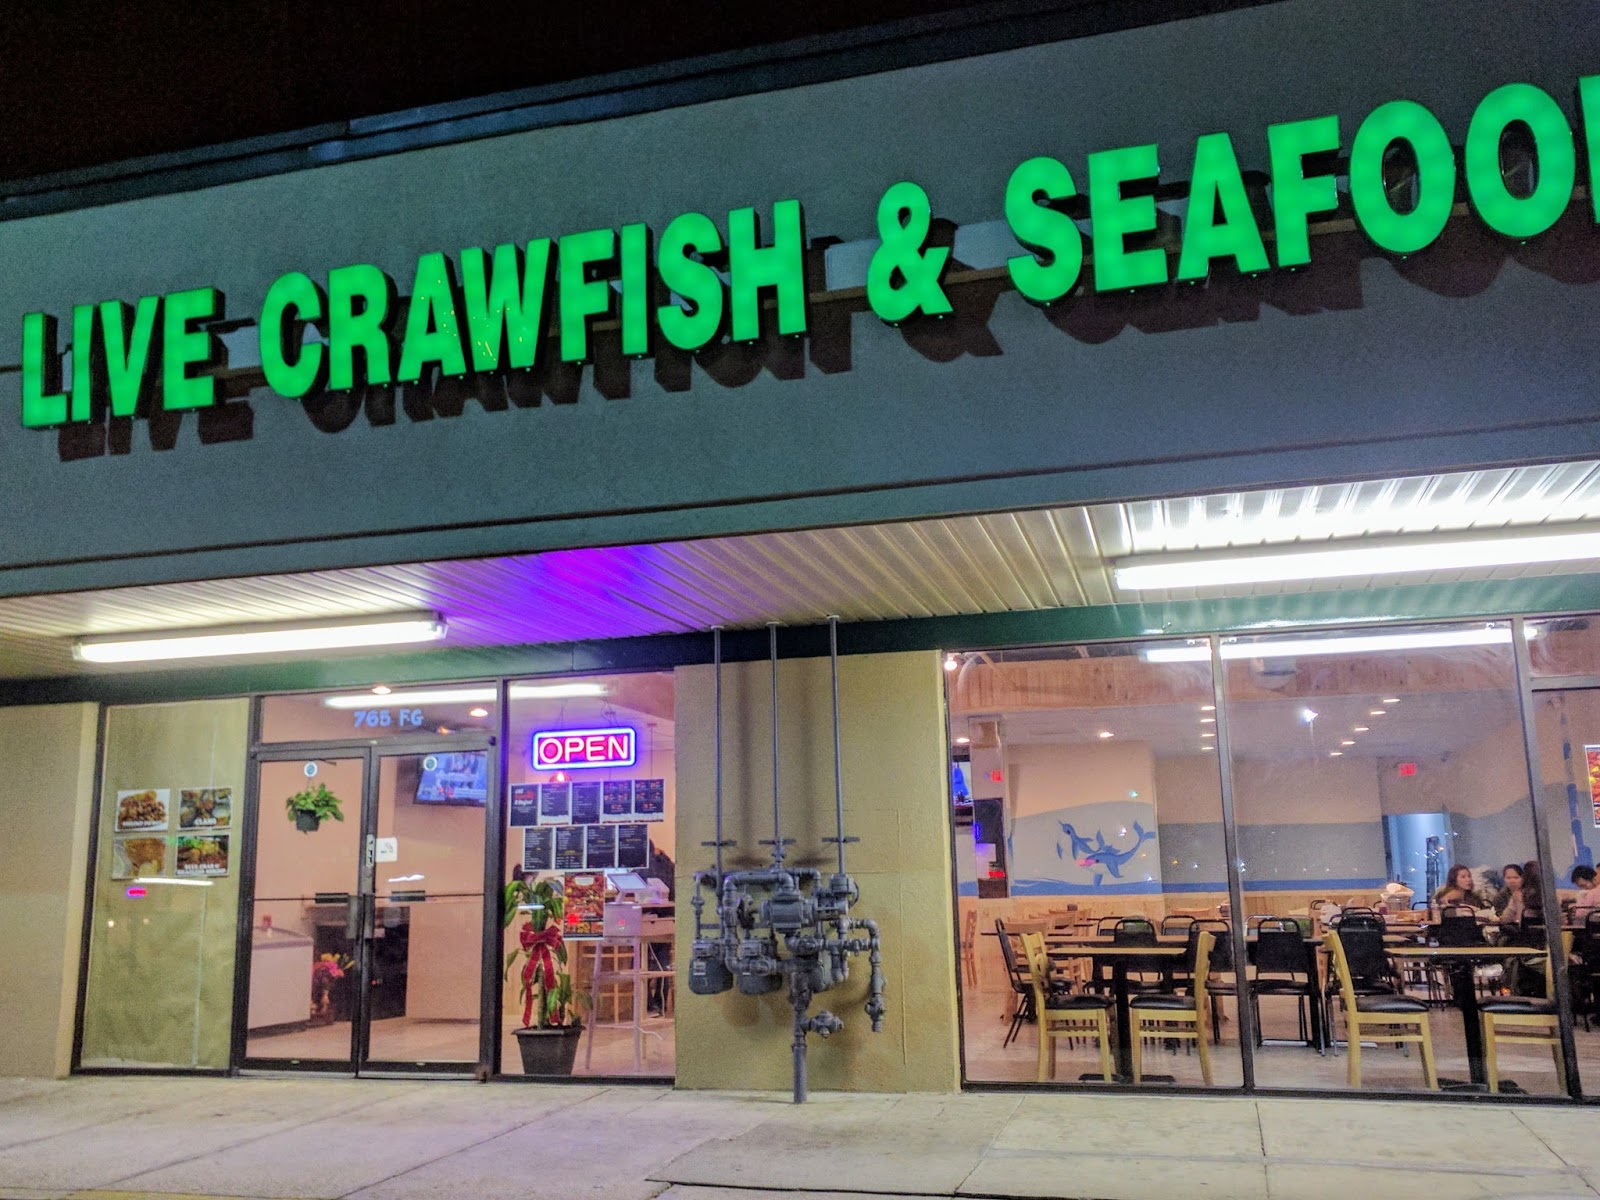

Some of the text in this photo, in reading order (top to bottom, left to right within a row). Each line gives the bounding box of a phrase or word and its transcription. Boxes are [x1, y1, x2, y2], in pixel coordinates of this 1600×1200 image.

[21, 75, 1600, 428] LIVE CRAWFISH & SEAFOO
[353, 708, 424, 728] 765 FG
[539, 735, 629, 764] OPEN
